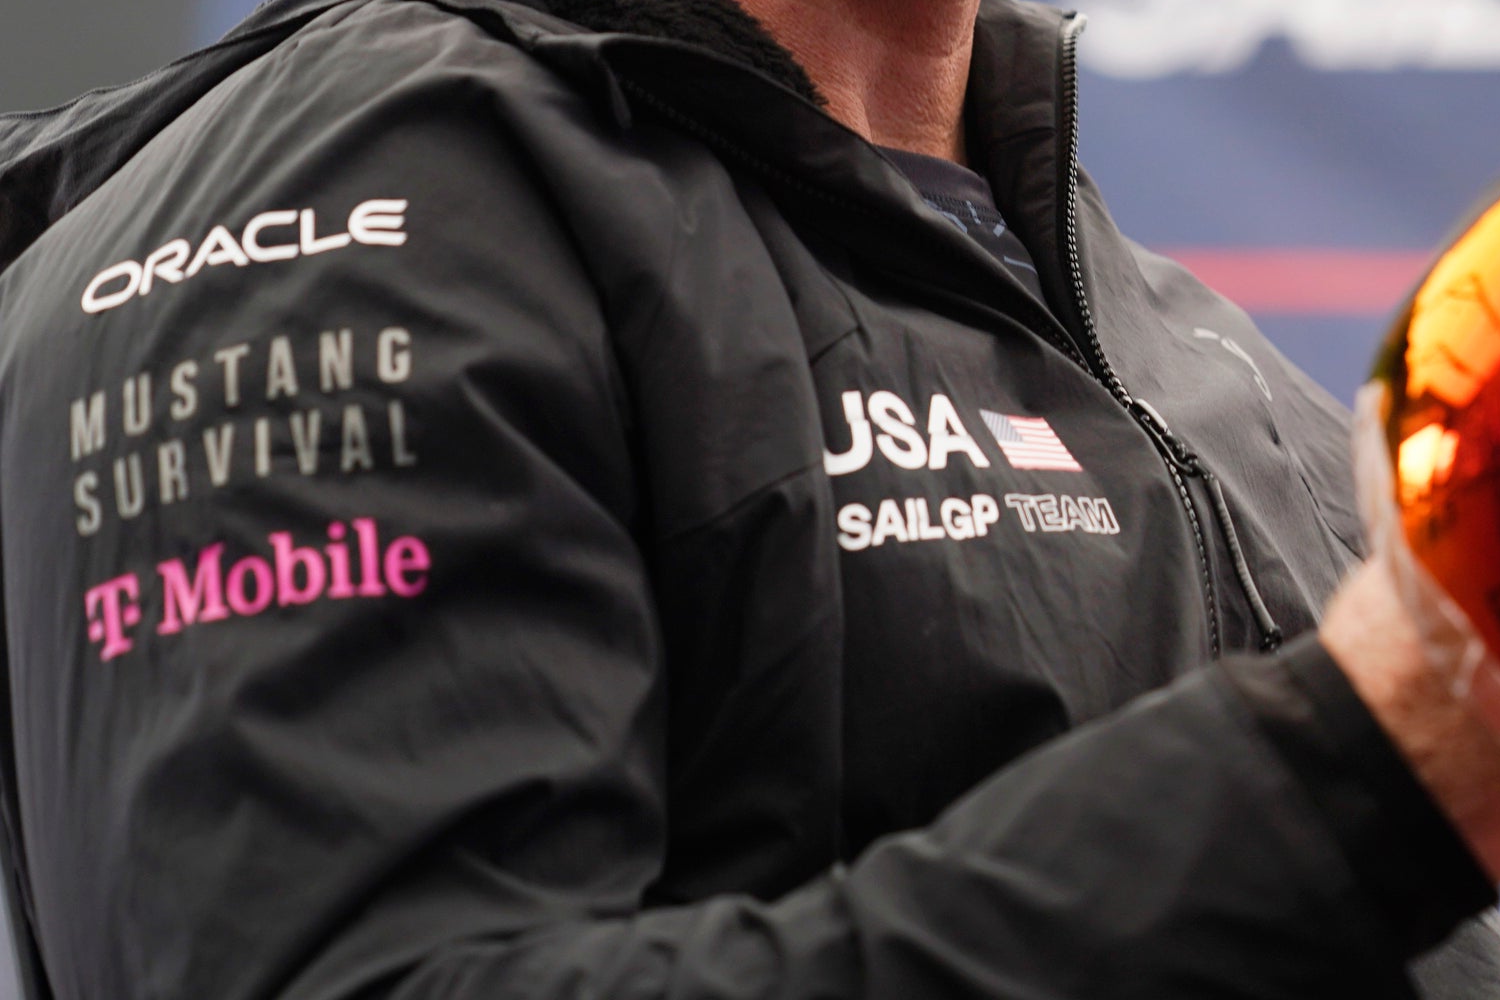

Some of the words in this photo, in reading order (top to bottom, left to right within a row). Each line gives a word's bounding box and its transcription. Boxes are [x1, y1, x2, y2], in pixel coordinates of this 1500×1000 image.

[81, 198, 408, 313] ORACLE
[70, 327, 412, 461] MUSTANG
[73, 400, 416, 535] SURVIVAL
[1004, 493, 1120, 535] TEAM
